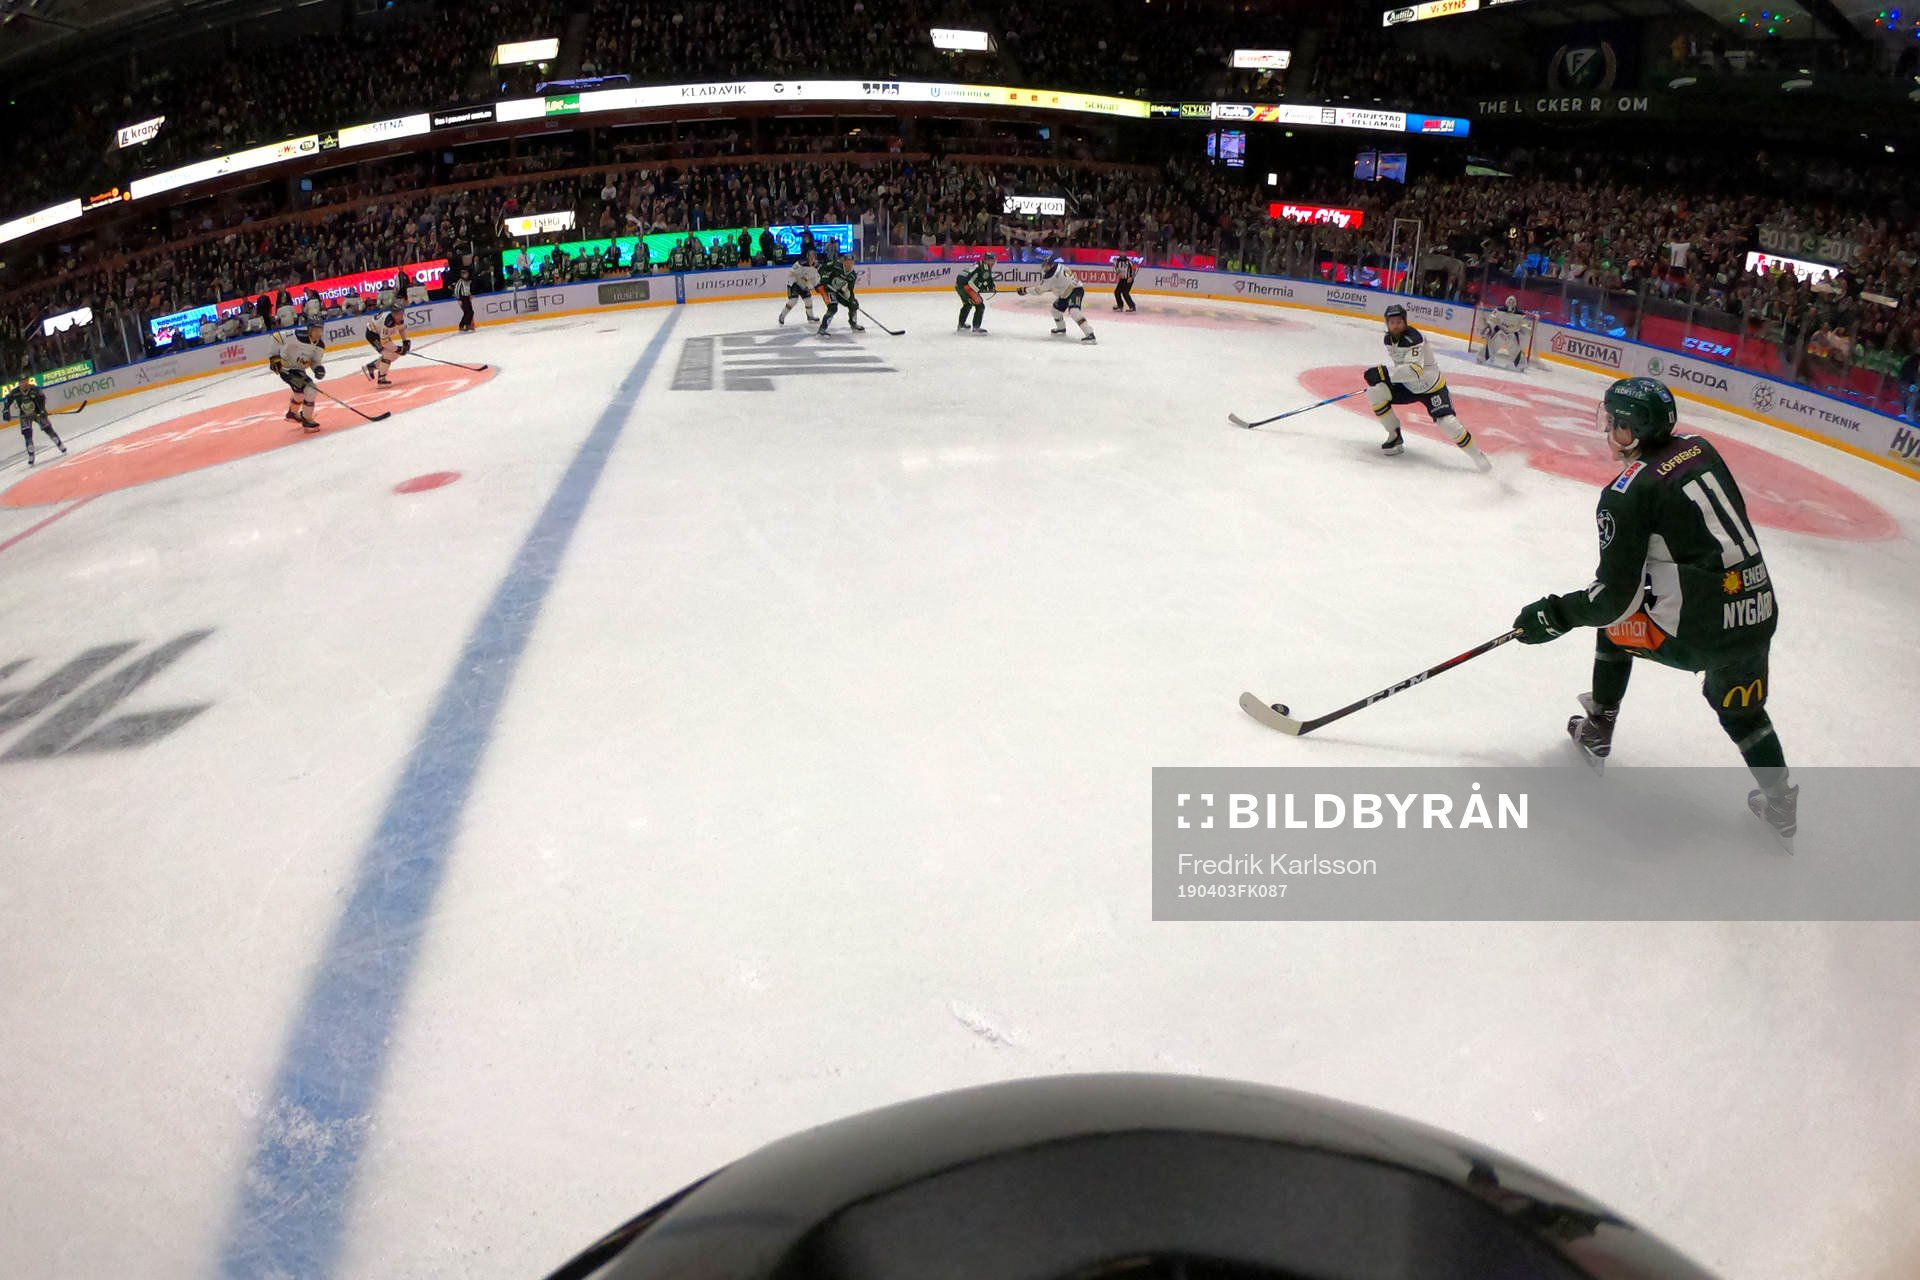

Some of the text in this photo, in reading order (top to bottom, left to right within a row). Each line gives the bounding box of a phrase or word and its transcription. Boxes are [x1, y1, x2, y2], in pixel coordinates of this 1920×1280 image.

[1478, 97, 1648, 114] THE LCKER ROM
[1247, 282, 1294, 298] Thermia
[1566, 340, 1622, 364] BYGMA
[1682, 337, 1732, 357] CCM
[1668, 363, 1729, 392] ŠKODA
[1819, 410, 1861, 432] TEKNIK
[1656, 445, 1702, 476] LÖFBERGS
[1682, 471, 1762, 570] 11
